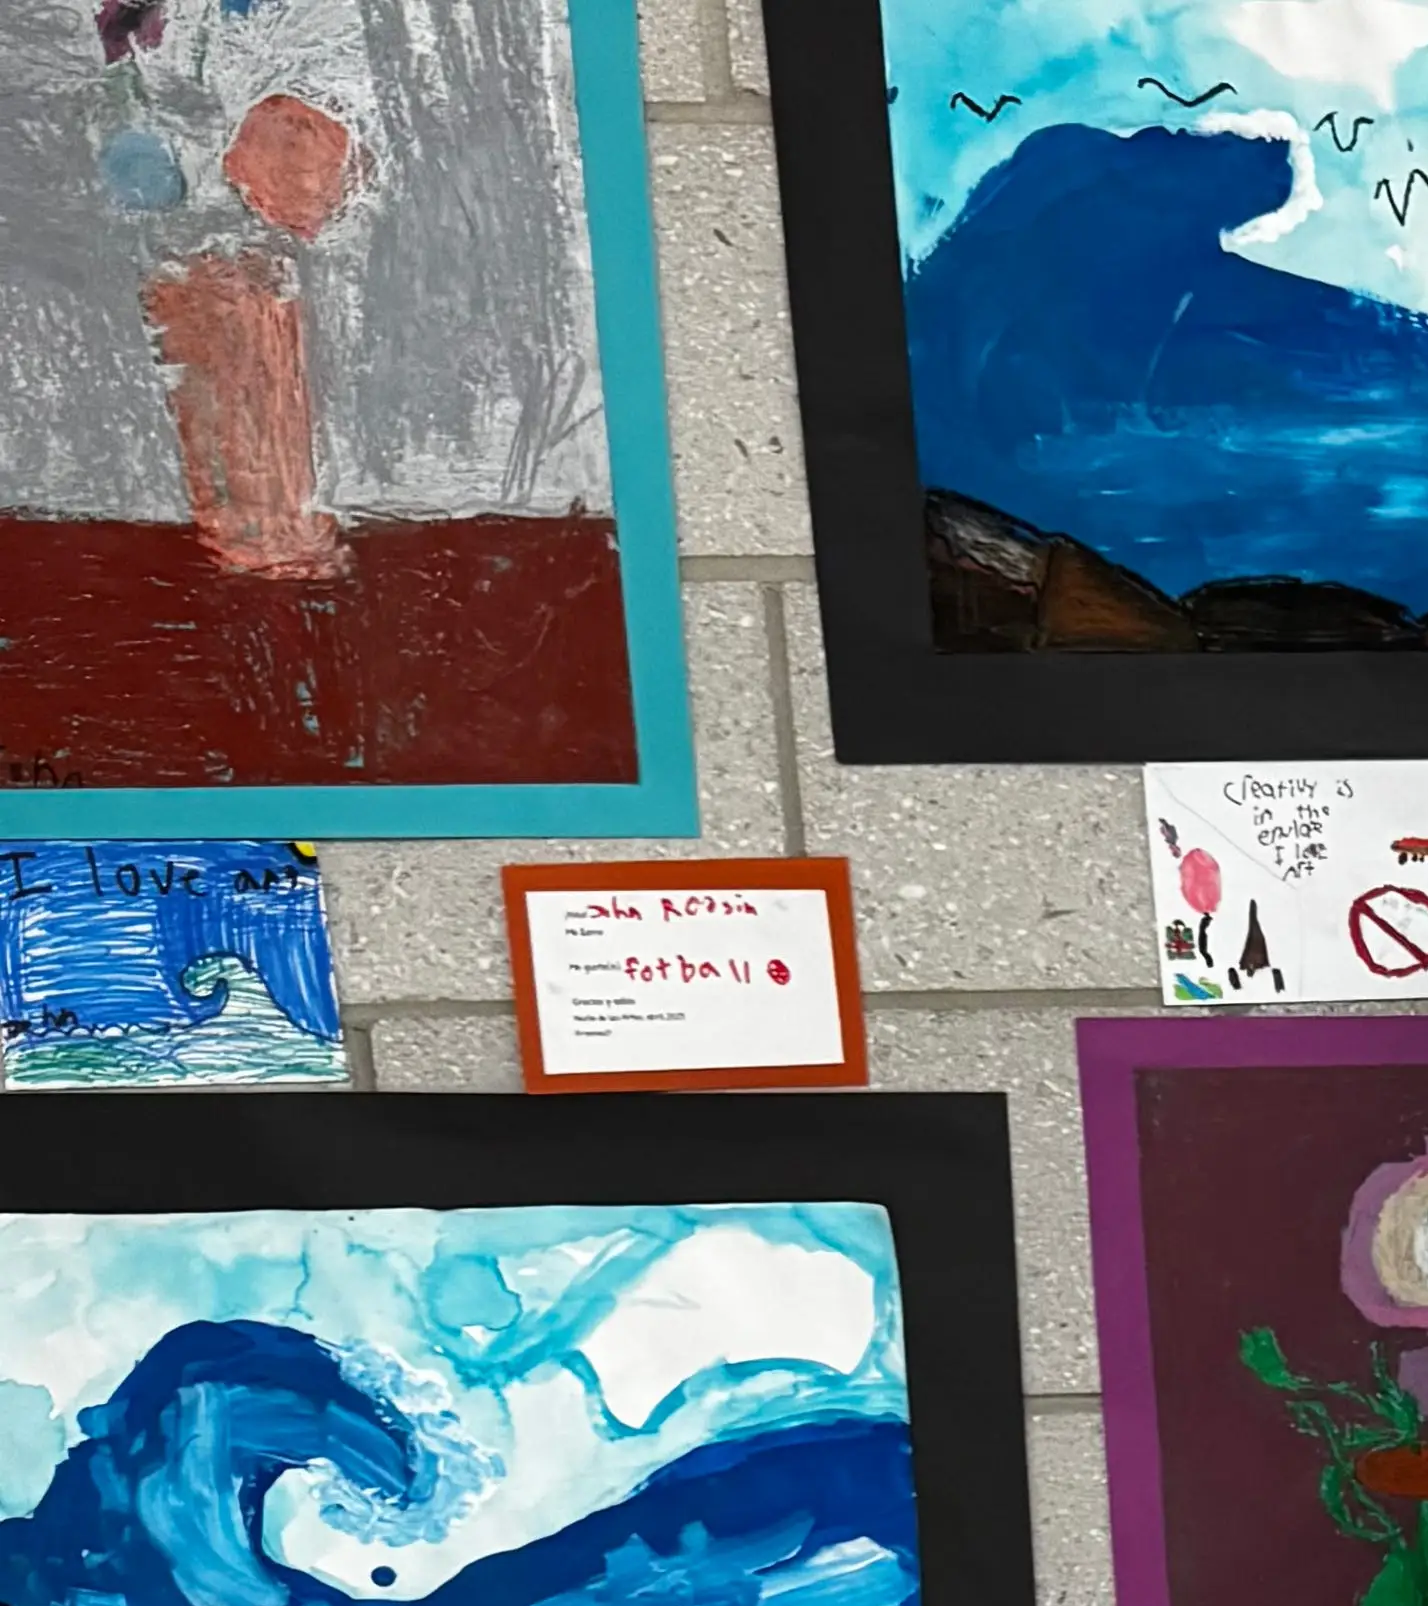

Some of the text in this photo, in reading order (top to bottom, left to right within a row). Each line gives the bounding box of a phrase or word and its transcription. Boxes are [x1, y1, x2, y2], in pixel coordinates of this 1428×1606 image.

[1335, 778, 1354, 799] is
[1253, 804, 1331, 827] in the
[0, 850, 52, 899] I
[85, 845, 208, 898] love
[624, 954, 751, 985] fotball
